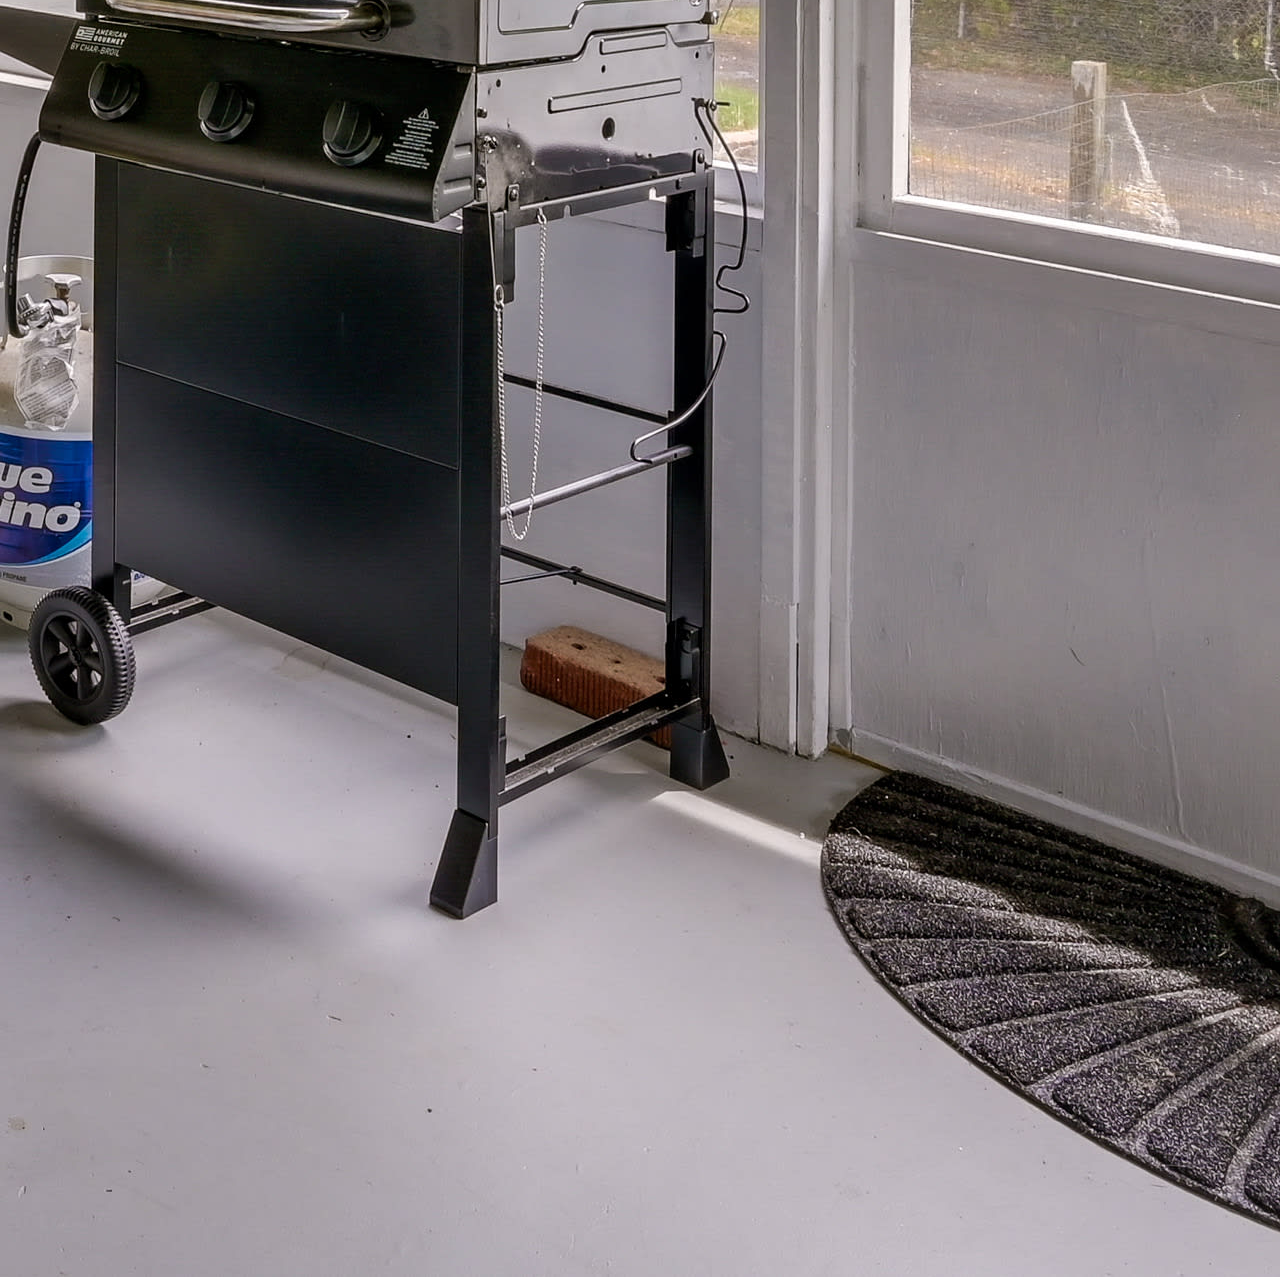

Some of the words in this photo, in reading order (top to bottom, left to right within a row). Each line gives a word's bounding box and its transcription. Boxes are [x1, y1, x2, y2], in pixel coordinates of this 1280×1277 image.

[95, 28, 128, 39] AMERICAN
[93, 35, 125, 46] GOURMET
[70, 42, 80, 50] BY
[80, 43, 120, 57] CHAR-BROIL
